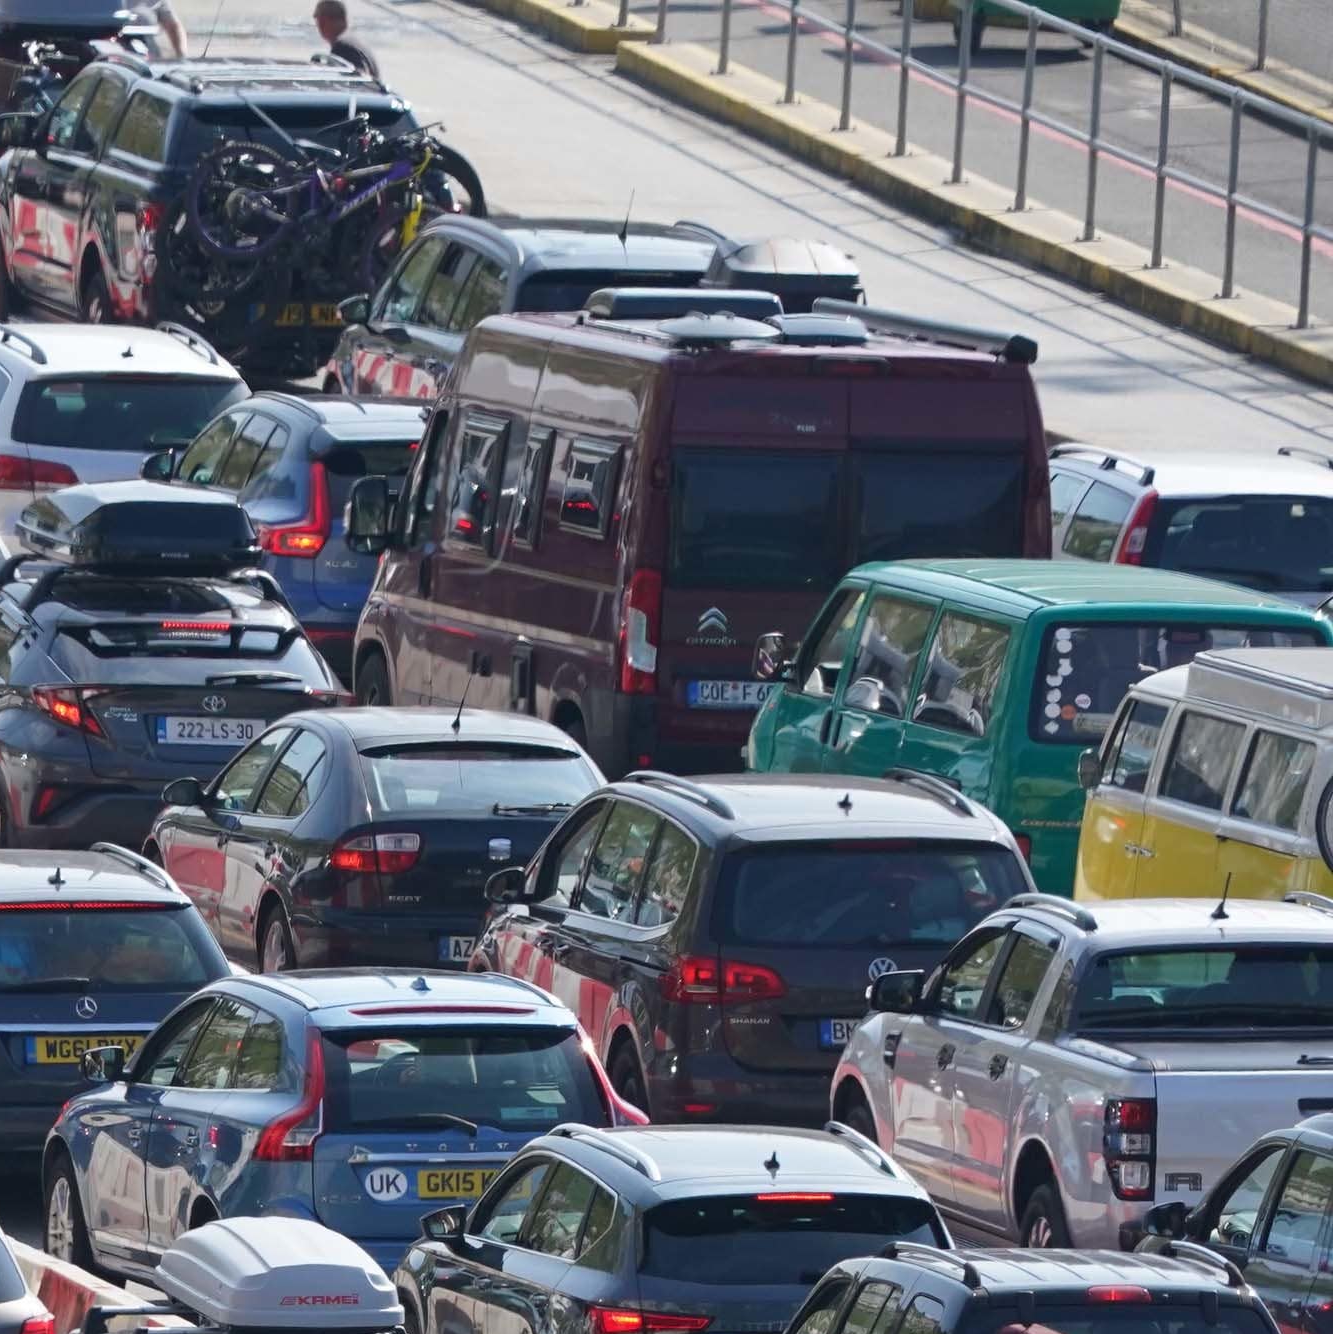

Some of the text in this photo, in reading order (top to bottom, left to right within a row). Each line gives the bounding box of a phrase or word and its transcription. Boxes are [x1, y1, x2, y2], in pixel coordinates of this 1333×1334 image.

[405, 1143, 510, 1152] VOLV
[370, 1175, 402, 1194] UK
[427, 1171, 476, 1195] GK15
